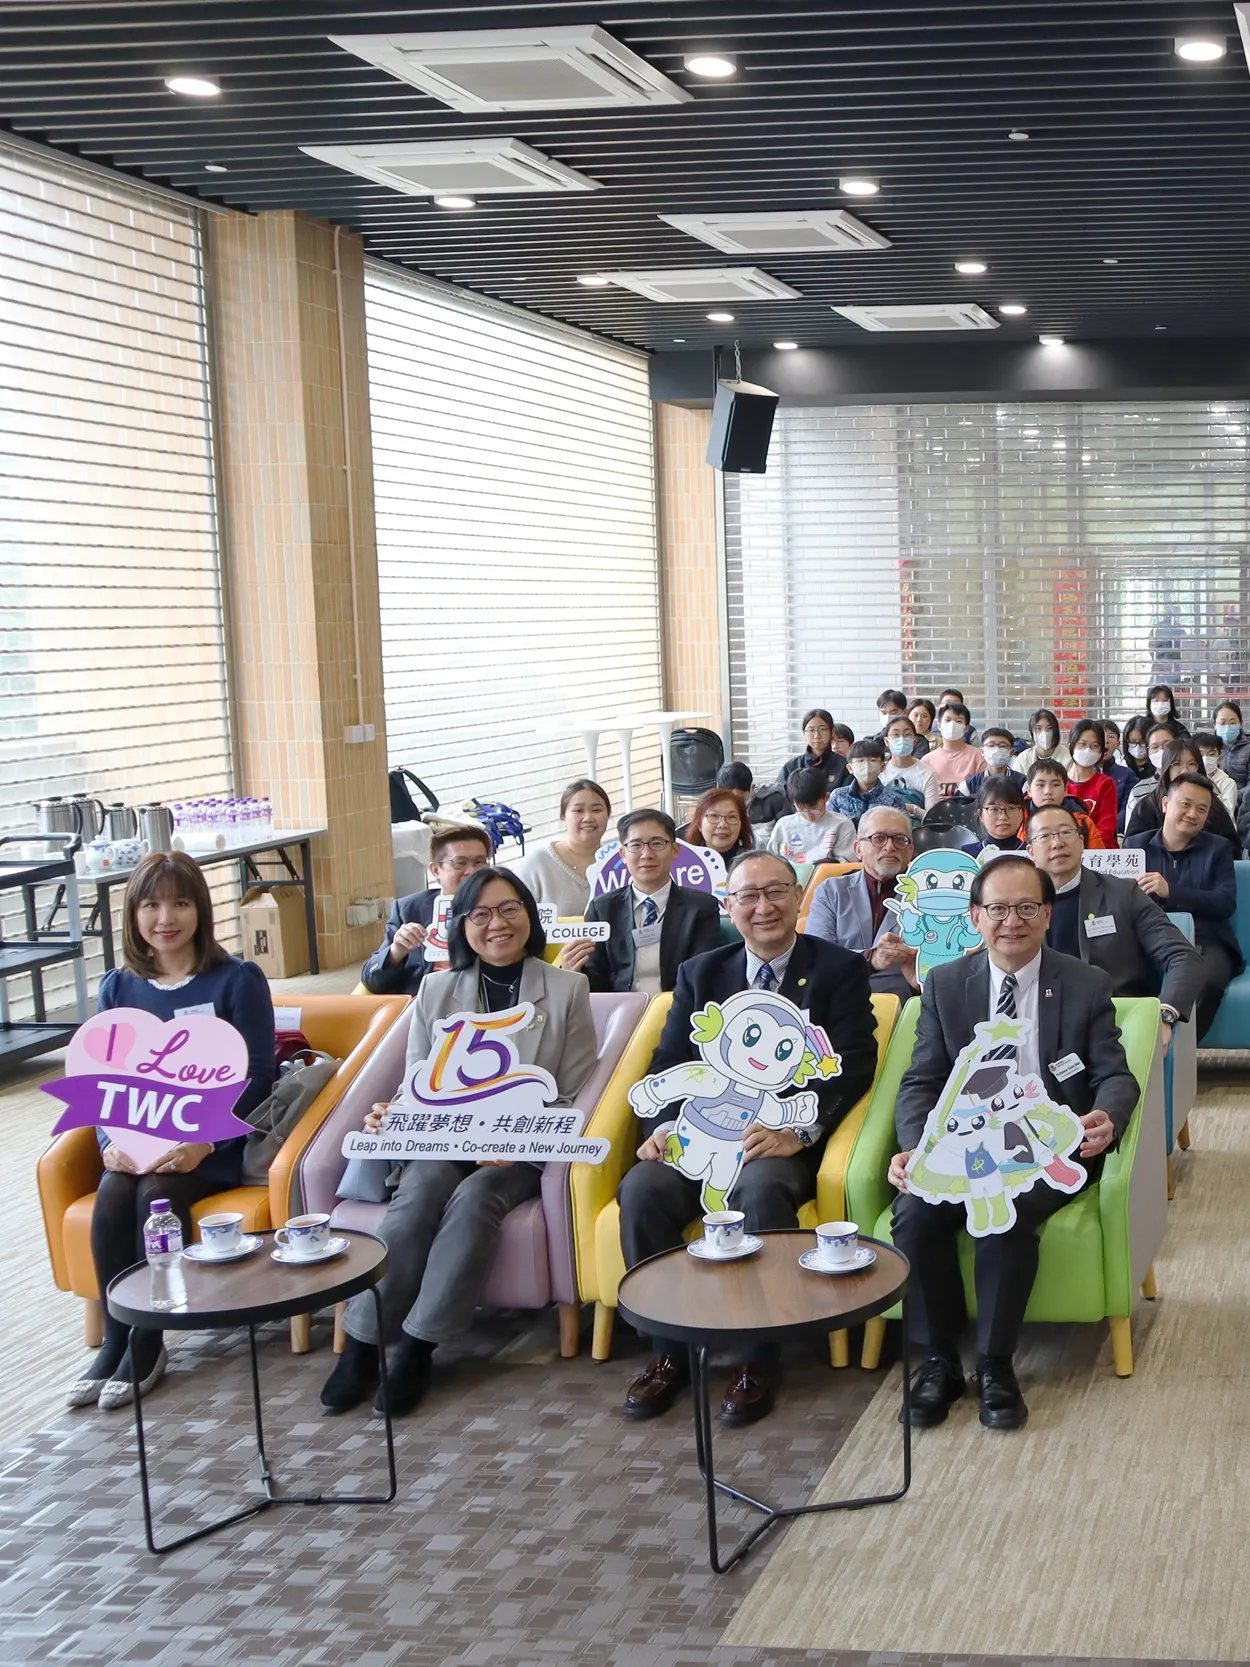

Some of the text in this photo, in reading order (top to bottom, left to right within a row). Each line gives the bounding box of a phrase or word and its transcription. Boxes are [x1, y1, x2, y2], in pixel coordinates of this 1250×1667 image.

[552, 927, 605, 939] COLLEGE
[106, 1024, 236, 1084] I Love
[430, 1010, 527, 1092] 15
[97, 1081, 203, 1132] TWC
[350, 1139, 377, 1153] Leap
[381, 1139, 401, 1152] into
[405, 1140, 449, 1152] Dreams
[462, 1140, 515, 1153] Co-create
[519, 1145, 526, 1153] a
[530, 1142, 553, 1154] New
[556, 1142, 602, 1157] Journey
